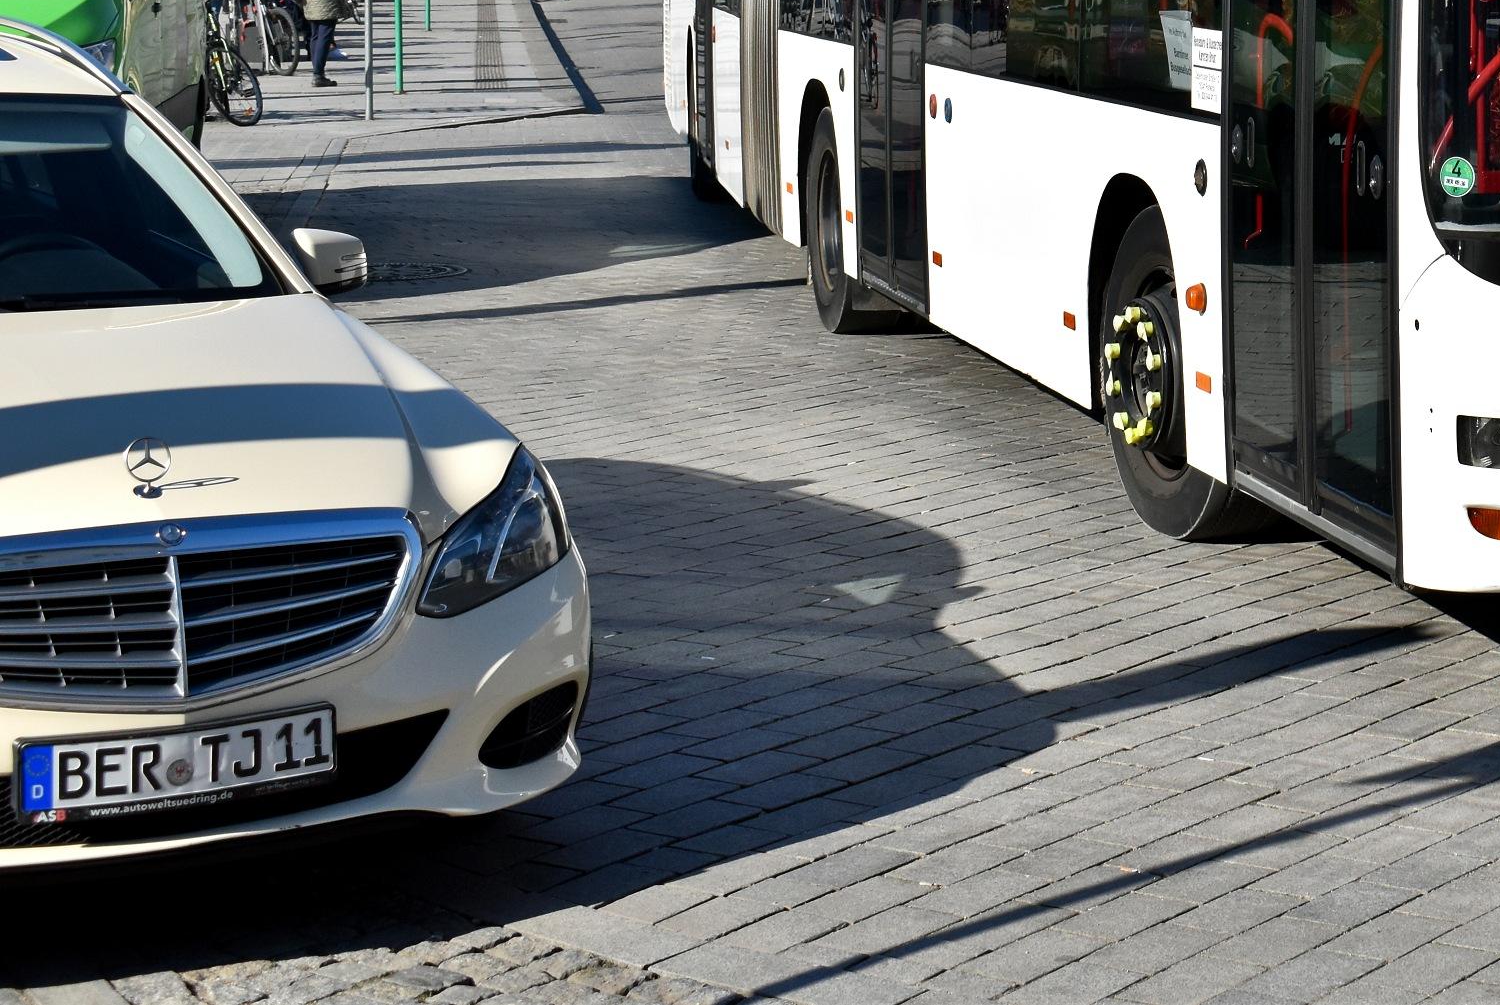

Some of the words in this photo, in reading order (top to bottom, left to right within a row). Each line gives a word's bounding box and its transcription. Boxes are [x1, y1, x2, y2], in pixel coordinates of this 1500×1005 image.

[1451, 159, 1462, 177] 4
[58, 743, 162, 800] BER
[31, 784, 44, 800] D
[90, 790, 234, 818] www.autoweltsuedring.de
[37, 809, 67, 824] ASB
